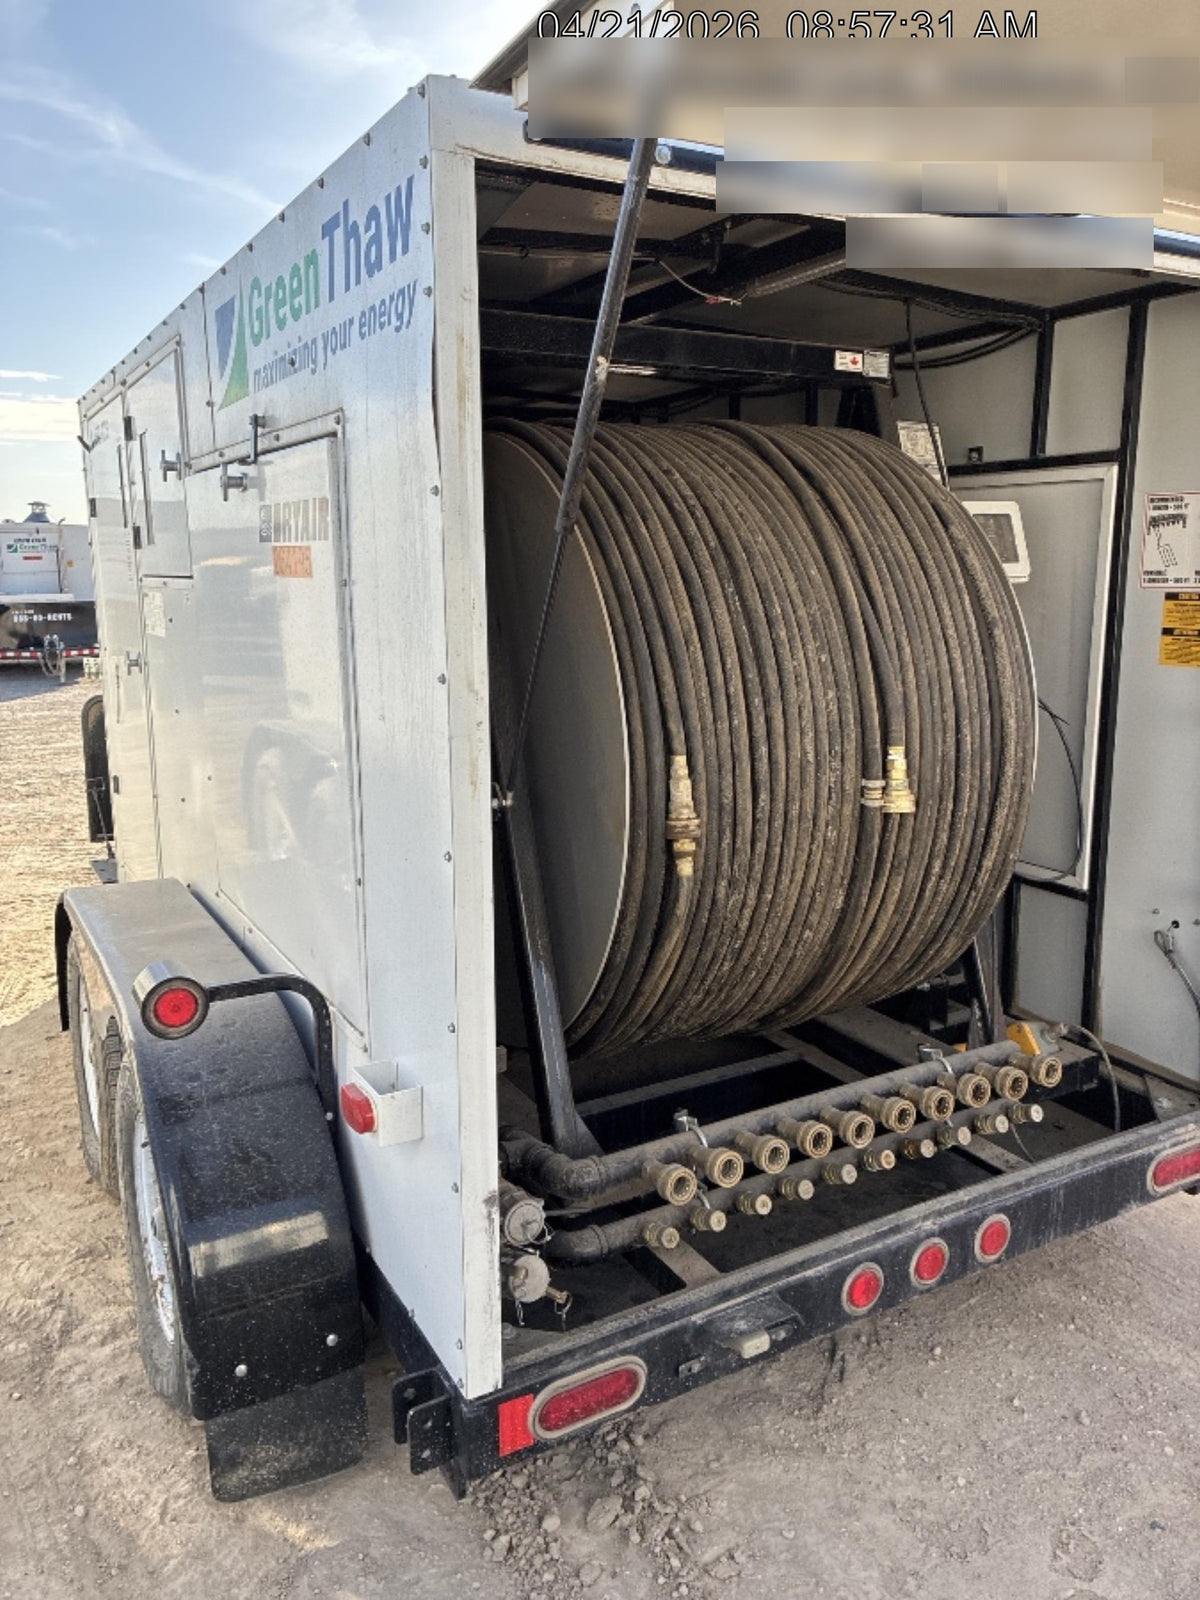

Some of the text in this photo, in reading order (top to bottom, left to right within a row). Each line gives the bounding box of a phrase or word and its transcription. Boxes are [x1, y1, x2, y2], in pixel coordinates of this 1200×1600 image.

[253, 279, 418, 393] maximizing your energy
